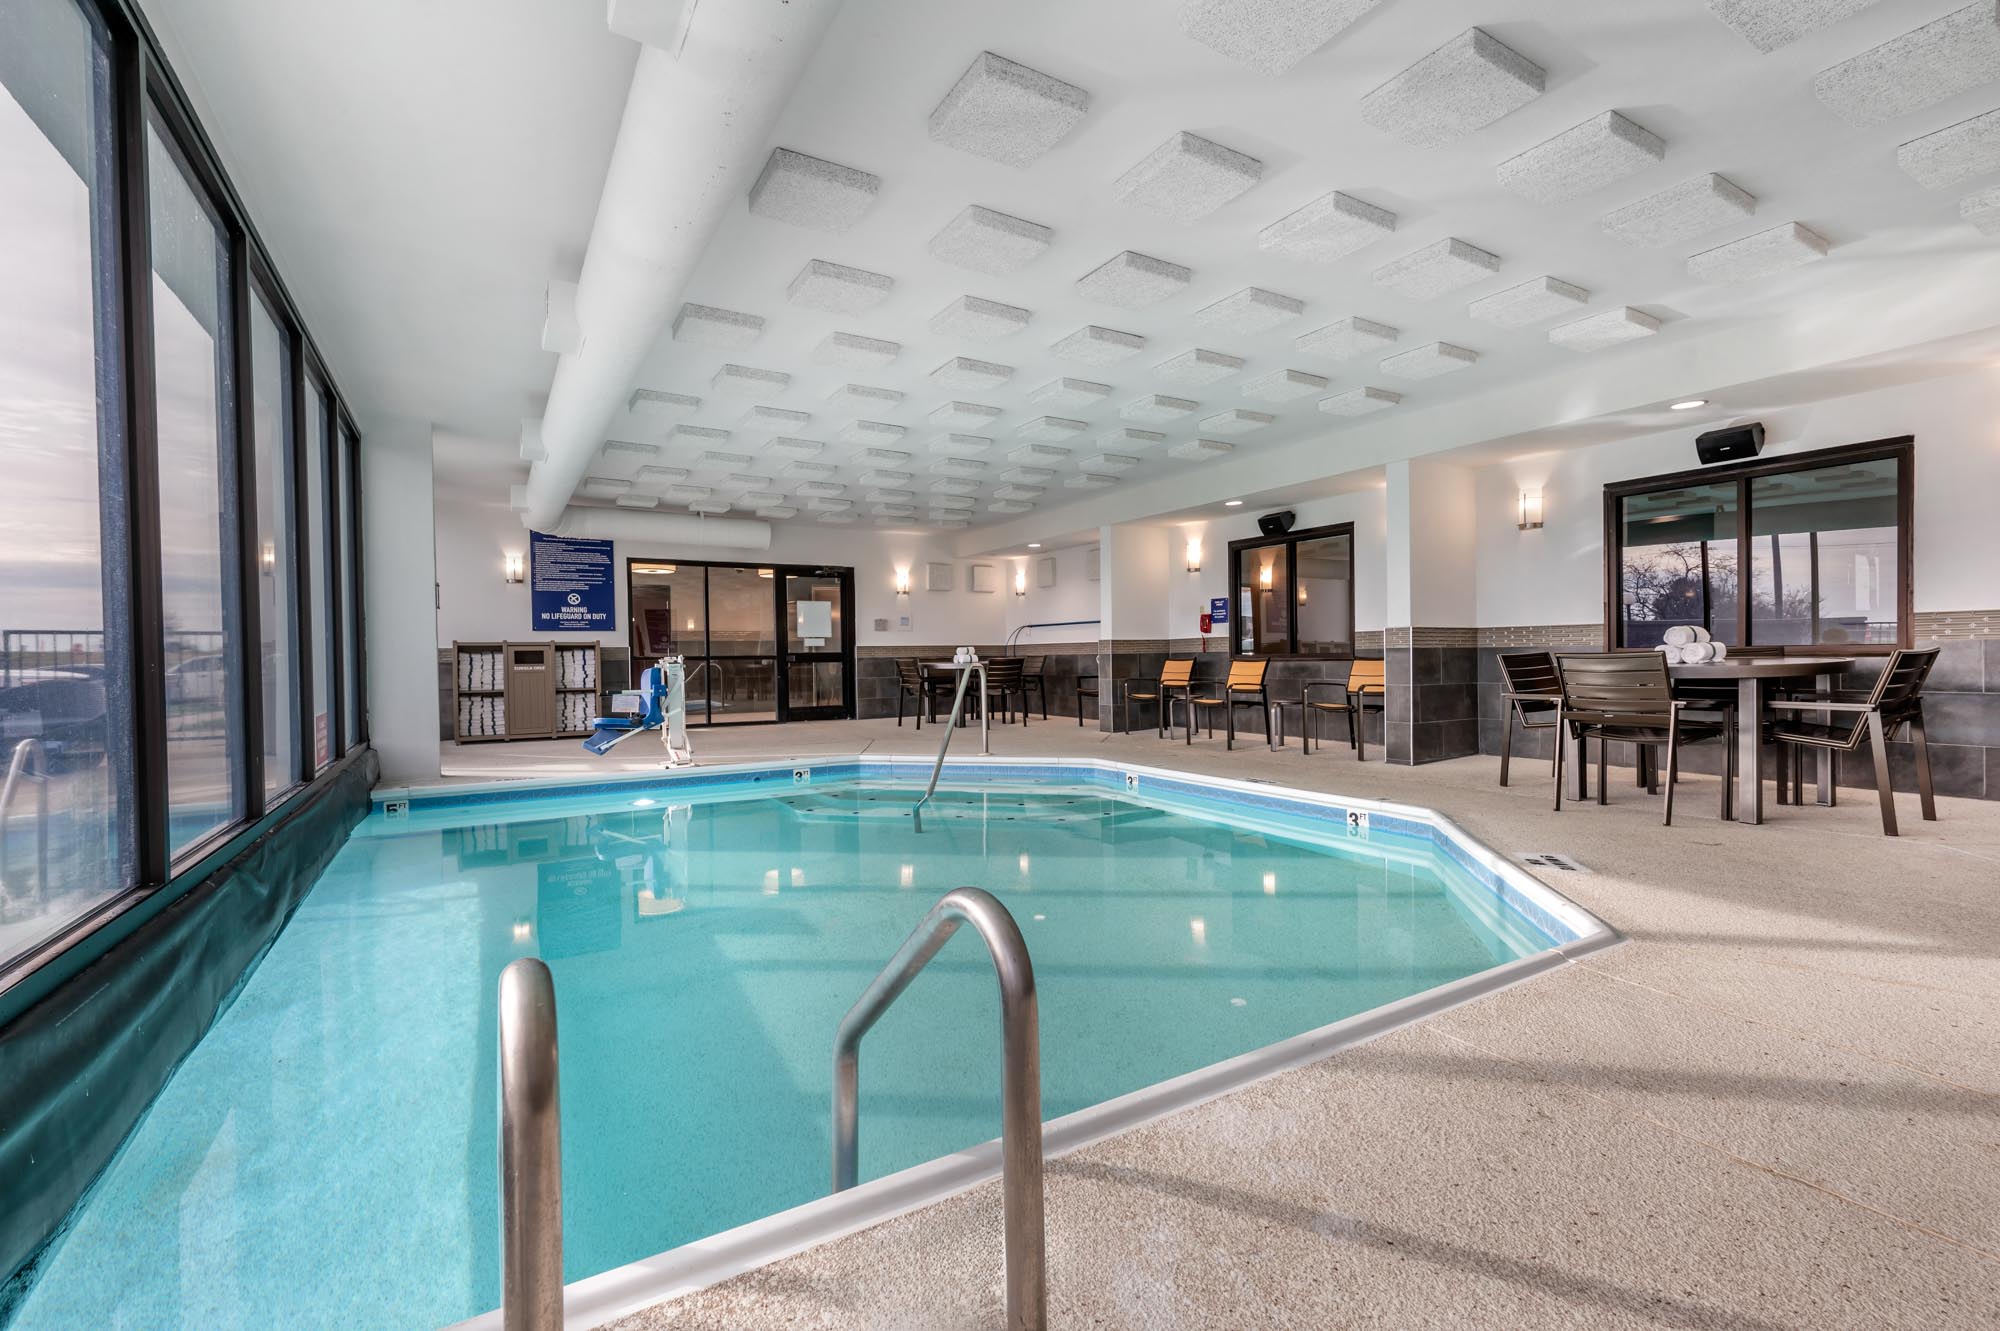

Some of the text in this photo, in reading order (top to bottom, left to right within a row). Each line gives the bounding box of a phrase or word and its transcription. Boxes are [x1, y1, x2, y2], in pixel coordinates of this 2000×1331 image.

[541, 612, 550, 620] NO
[551, 612, 582, 620] LIFEGUARD
[1359, 812, 1367, 820] FT
